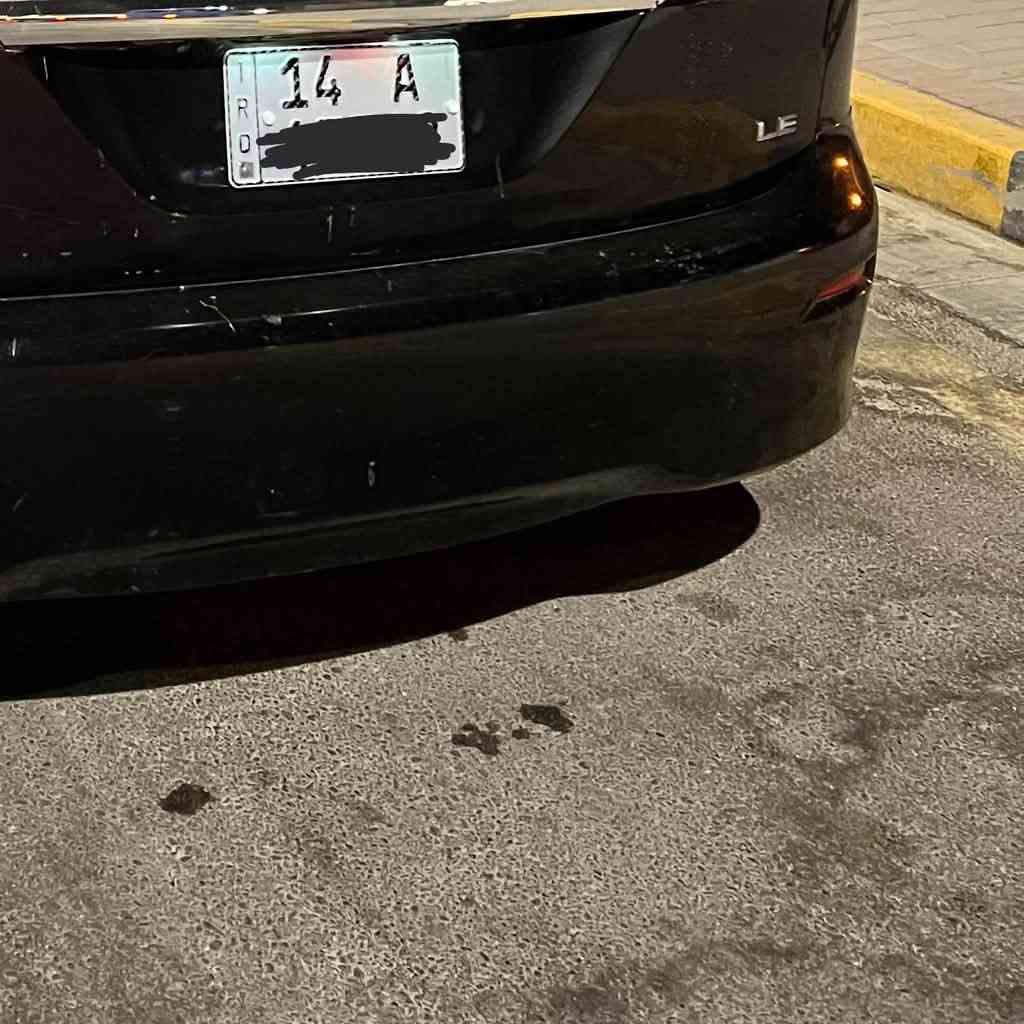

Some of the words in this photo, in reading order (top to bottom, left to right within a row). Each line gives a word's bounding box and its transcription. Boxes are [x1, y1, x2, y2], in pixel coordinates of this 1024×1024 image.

[281, 55, 342, 109] 14
[394, 53, 419, 103] A
[755, 114, 798, 142] LE
